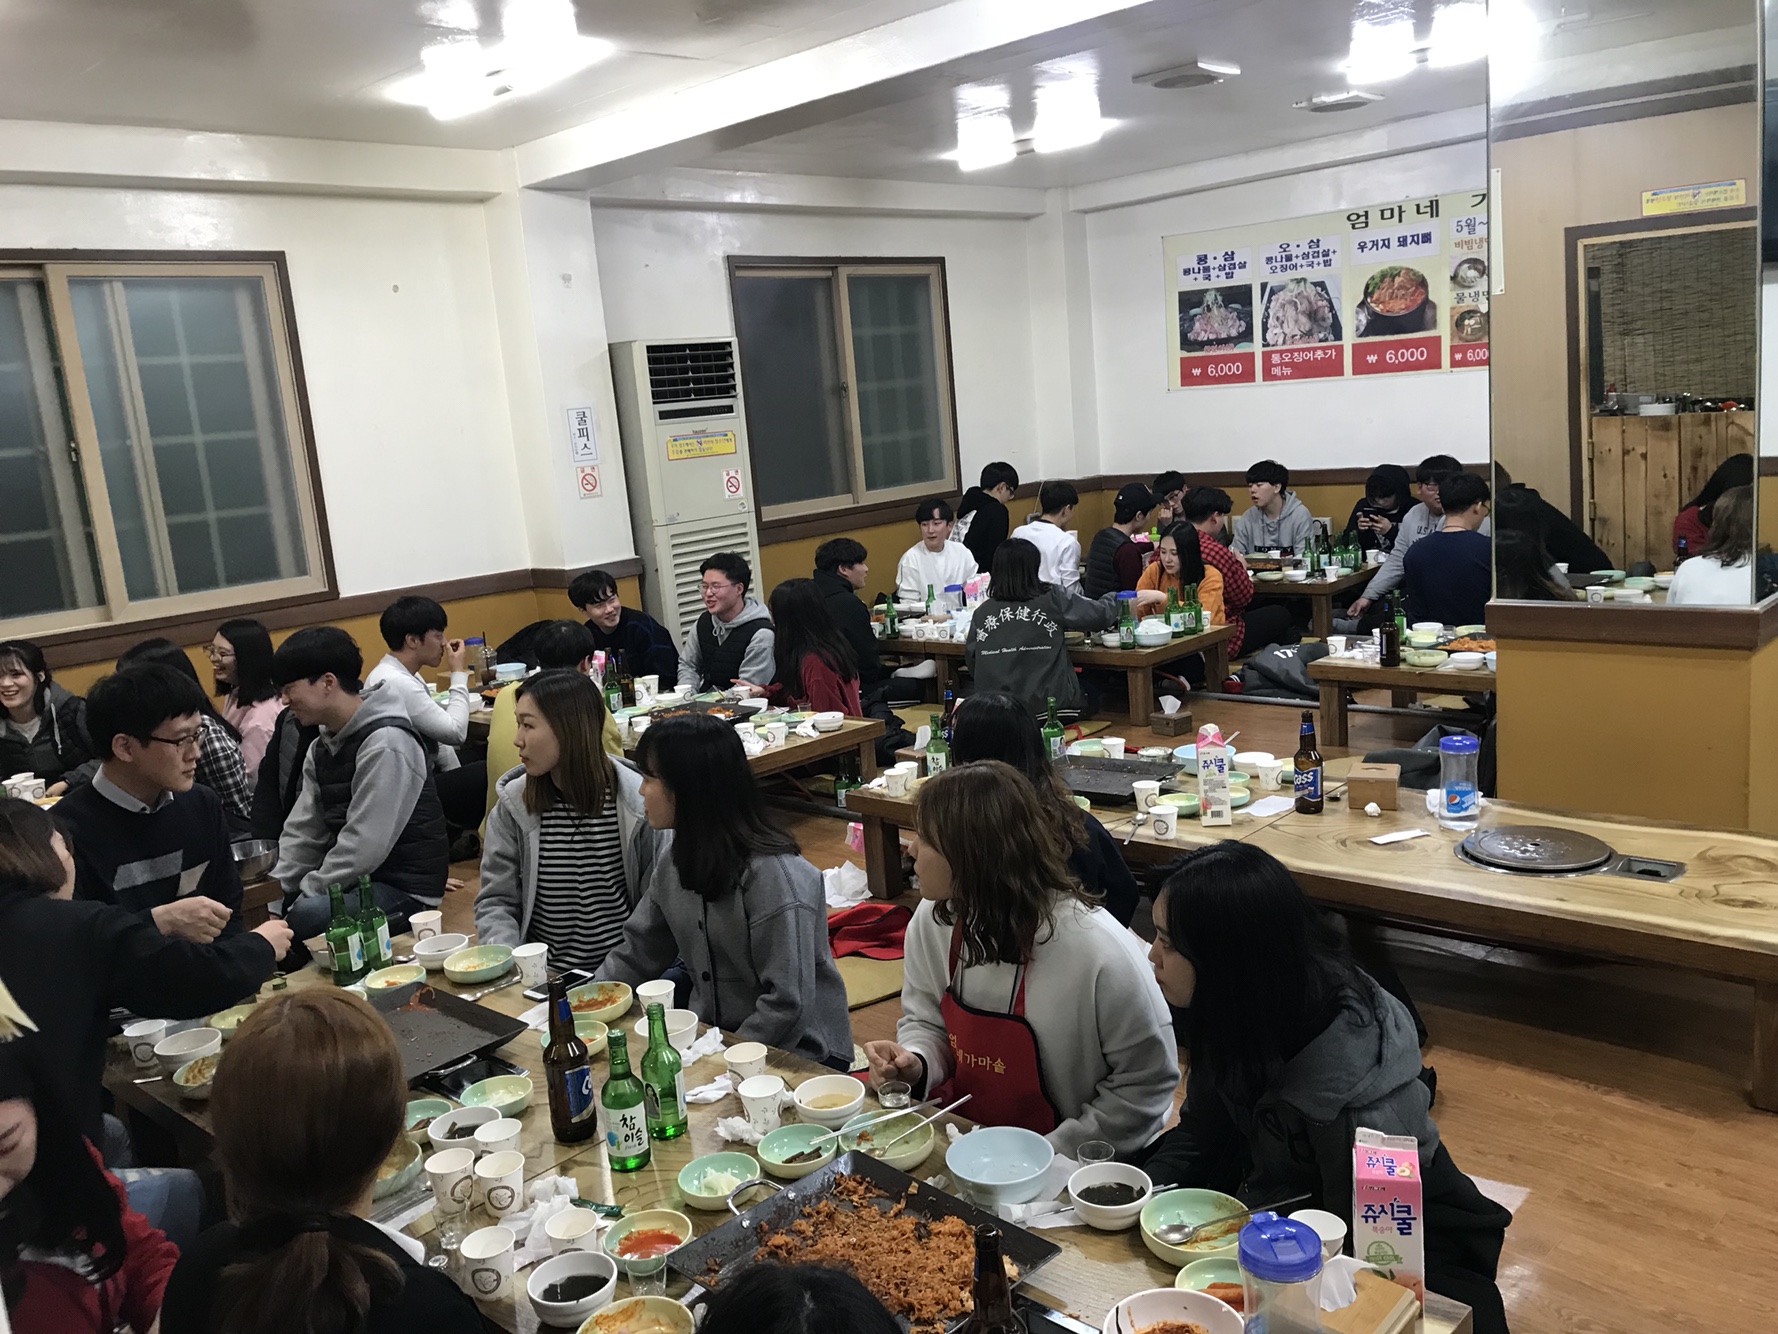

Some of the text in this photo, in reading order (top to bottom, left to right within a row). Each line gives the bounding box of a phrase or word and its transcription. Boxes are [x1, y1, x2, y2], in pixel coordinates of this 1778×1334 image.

[1357, 238, 1391, 253] 우거지
[1271, 349, 1337, 364] 통오징어추가
[1386, 347, 1427, 364] 6,000
[1208, 362, 1243, 377] 6,000
[1271, 366, 1293, 376] 메뉴
[575, 411, 593, 456] 쿨피스
[1202, 757, 1226, 773] 쥬시쿨
[1366, 1156, 1397, 1176] 쥬시쿨
[1361, 1202, 1417, 1235] 쥬시쿨
